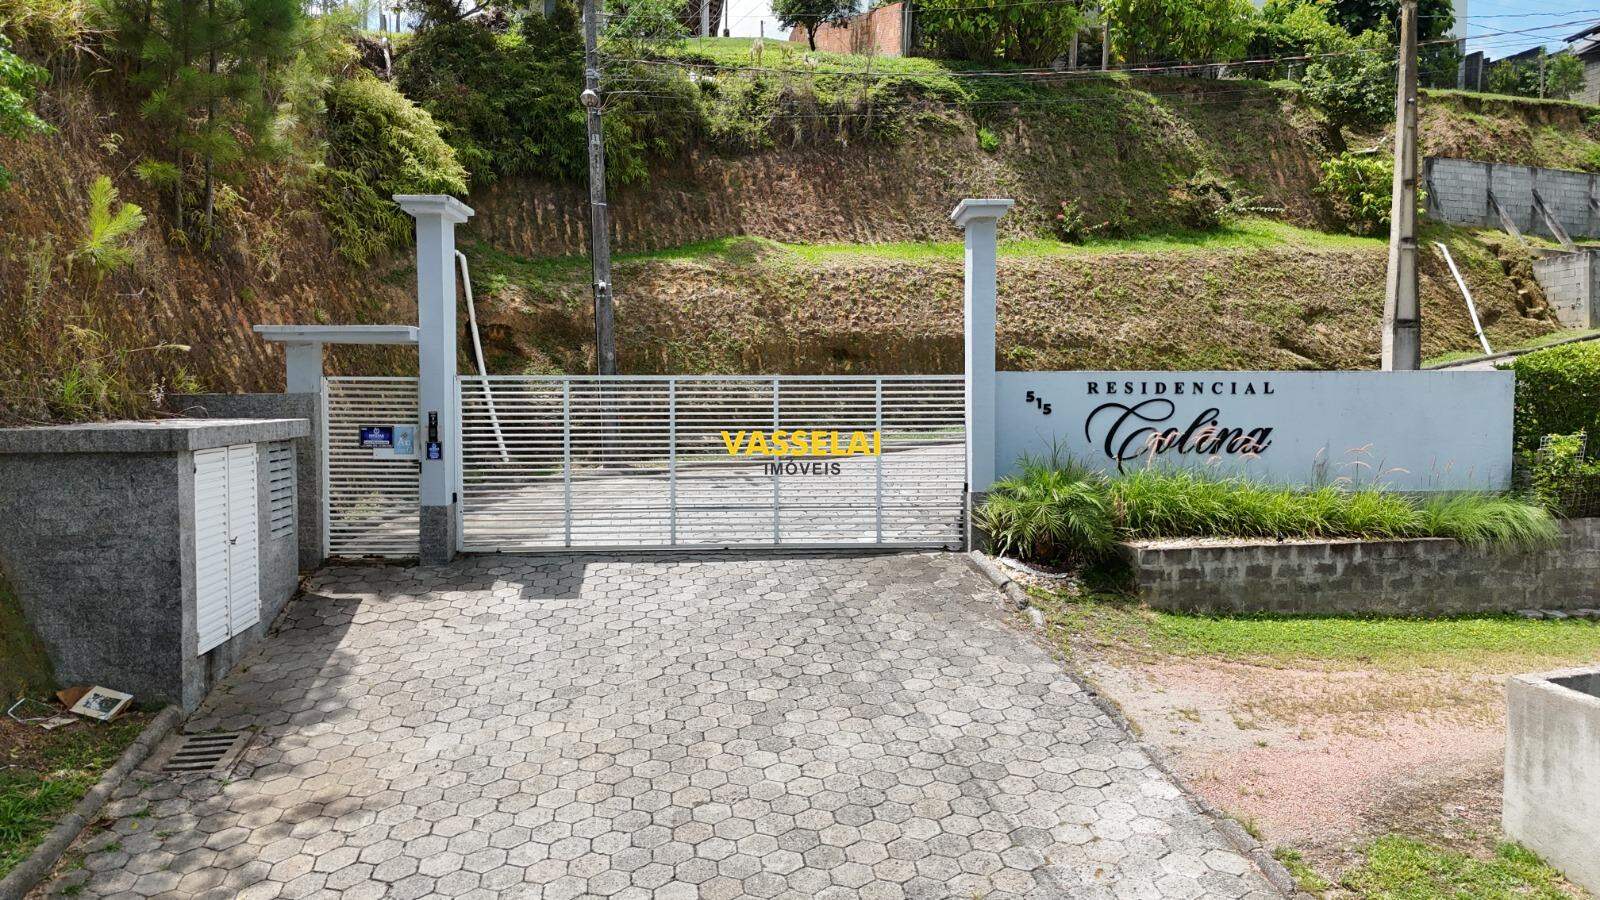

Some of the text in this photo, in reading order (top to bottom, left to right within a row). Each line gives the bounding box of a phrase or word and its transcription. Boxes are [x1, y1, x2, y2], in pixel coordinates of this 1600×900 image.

[1087, 381, 1275, 395] RESIDENCIAL
[1026, 390, 1052, 415] 515
[1084, 398, 1274, 475] Colina
